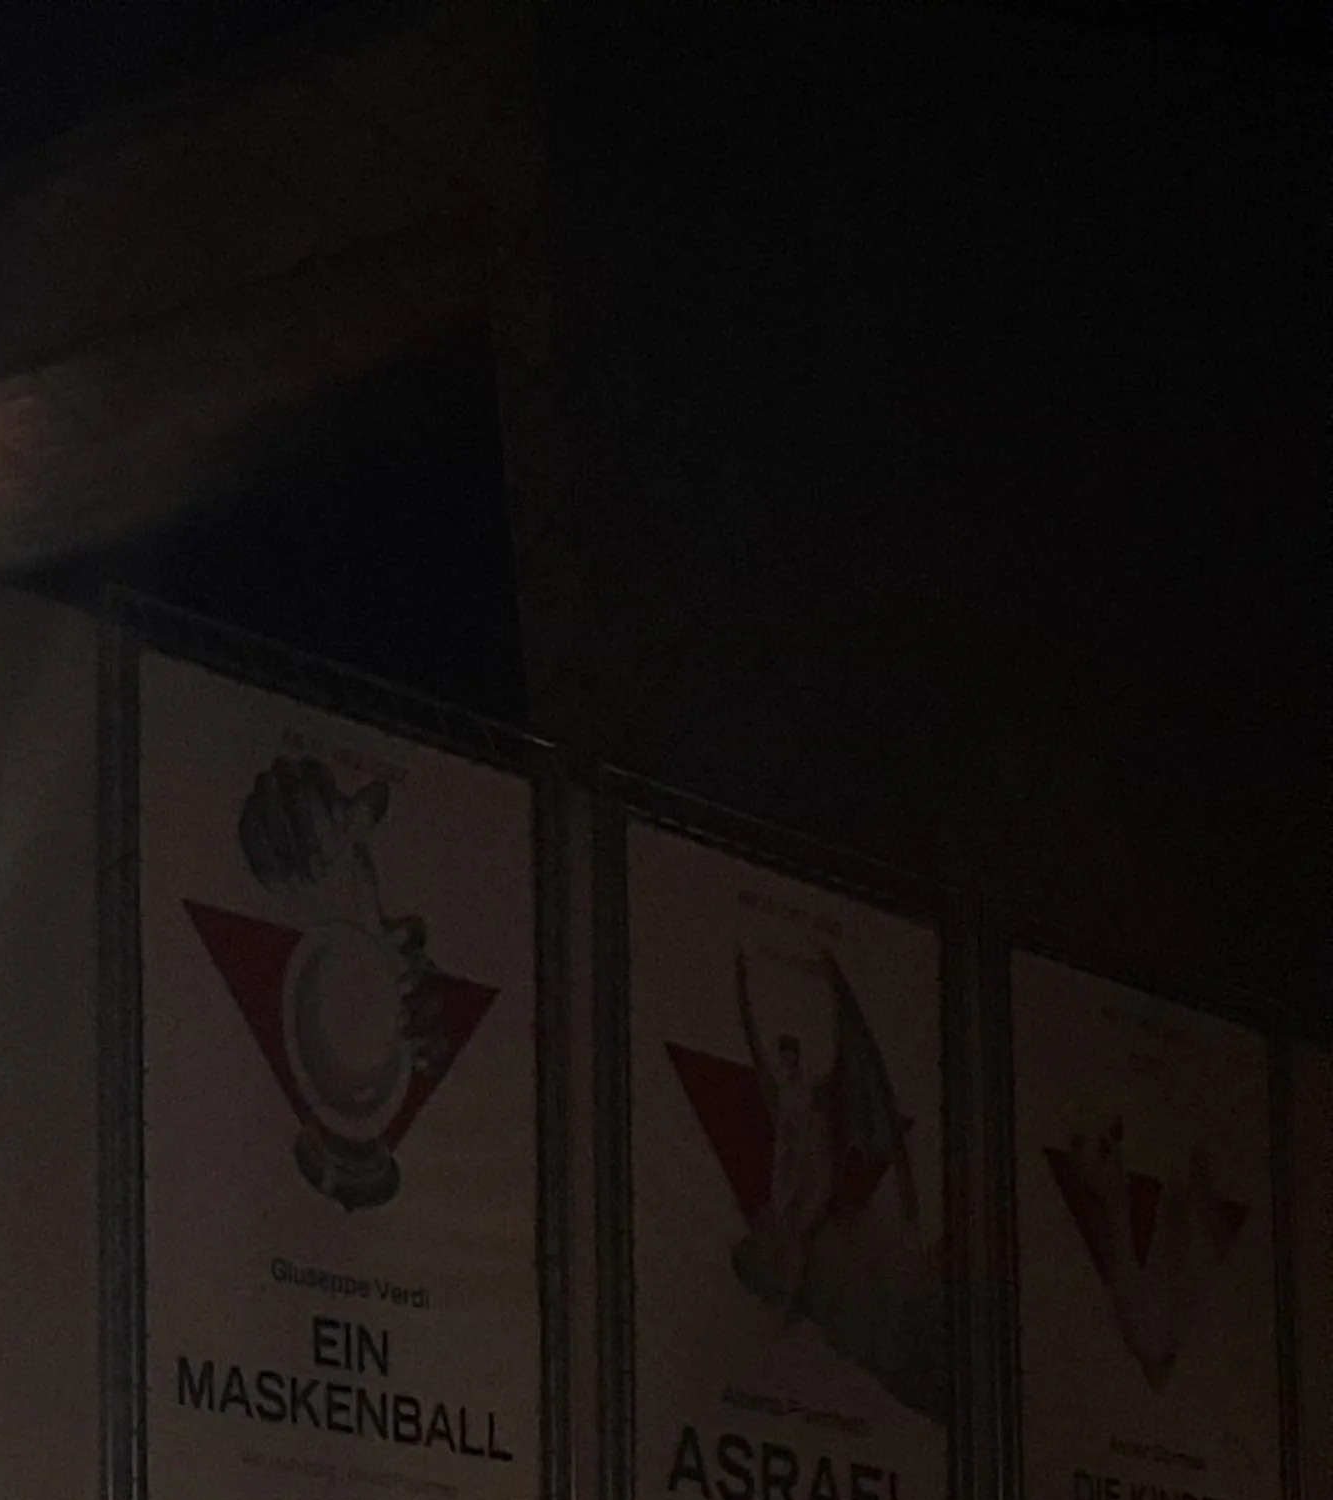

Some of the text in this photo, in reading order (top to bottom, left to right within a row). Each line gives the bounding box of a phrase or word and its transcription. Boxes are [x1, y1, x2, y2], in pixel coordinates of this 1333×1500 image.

[270, 1256, 431, 1310] Giuseppe Verdi
[312, 1314, 389, 1377] EIN
[176, 1355, 514, 1462] MASKENBALL
